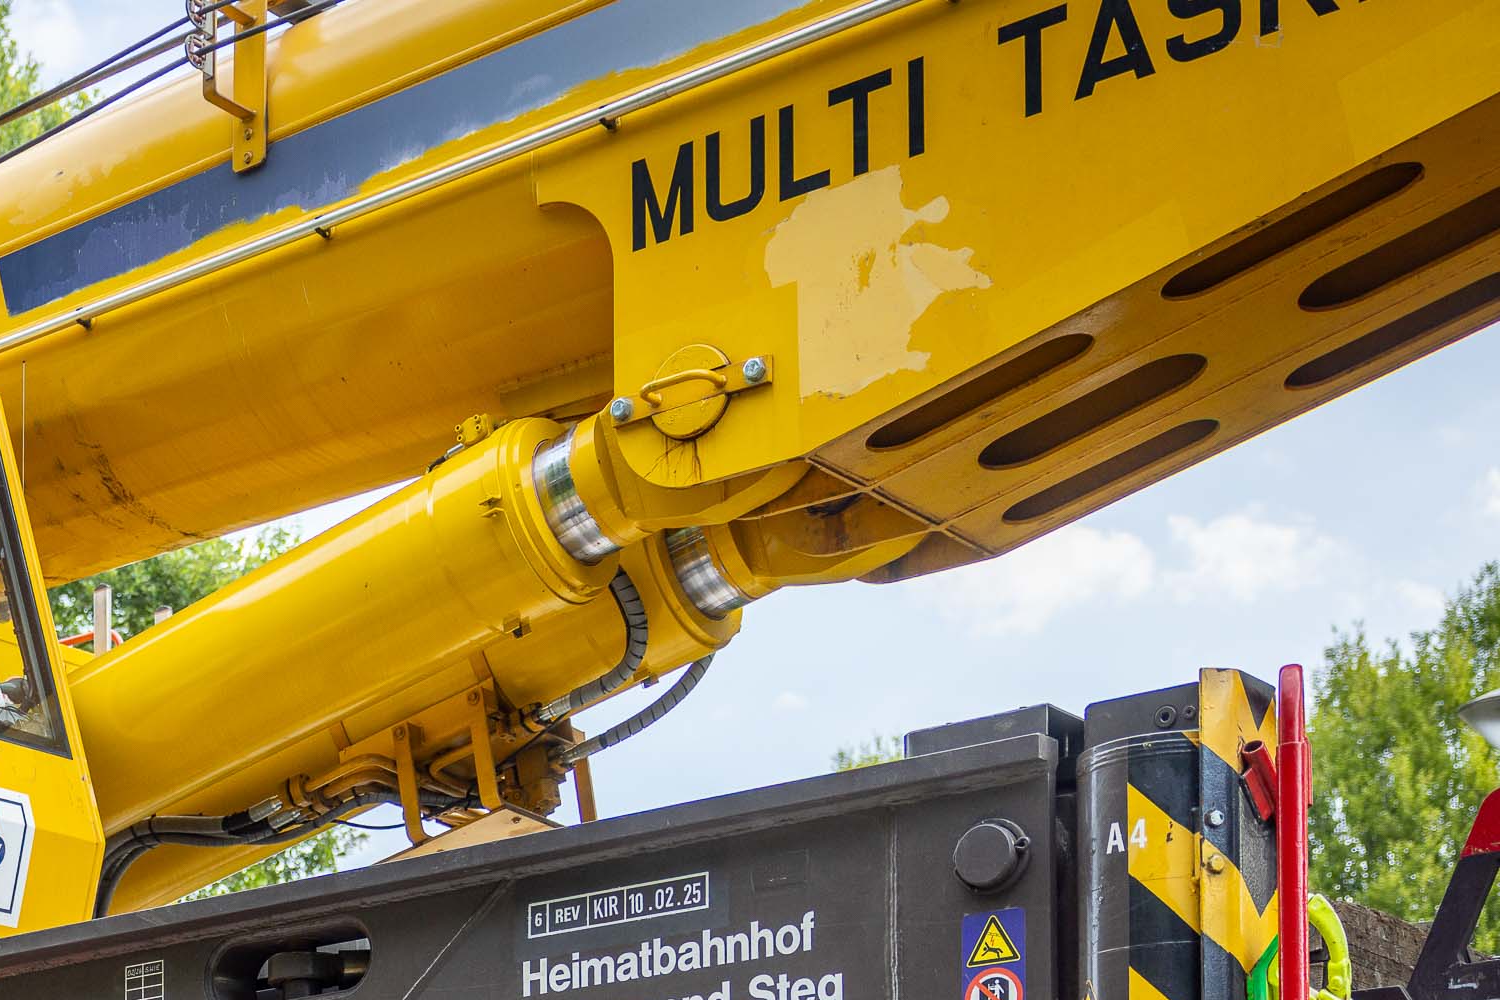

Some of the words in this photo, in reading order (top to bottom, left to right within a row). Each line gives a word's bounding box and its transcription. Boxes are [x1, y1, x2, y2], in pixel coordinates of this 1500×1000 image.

[631, 56, 925, 252] MULTI
[522, 911, 815, 998] Heimatbahnhof
[534, 912, 543, 927] 6
[554, 904, 581, 925] REV
[593, 895, 619, 920] KIR
